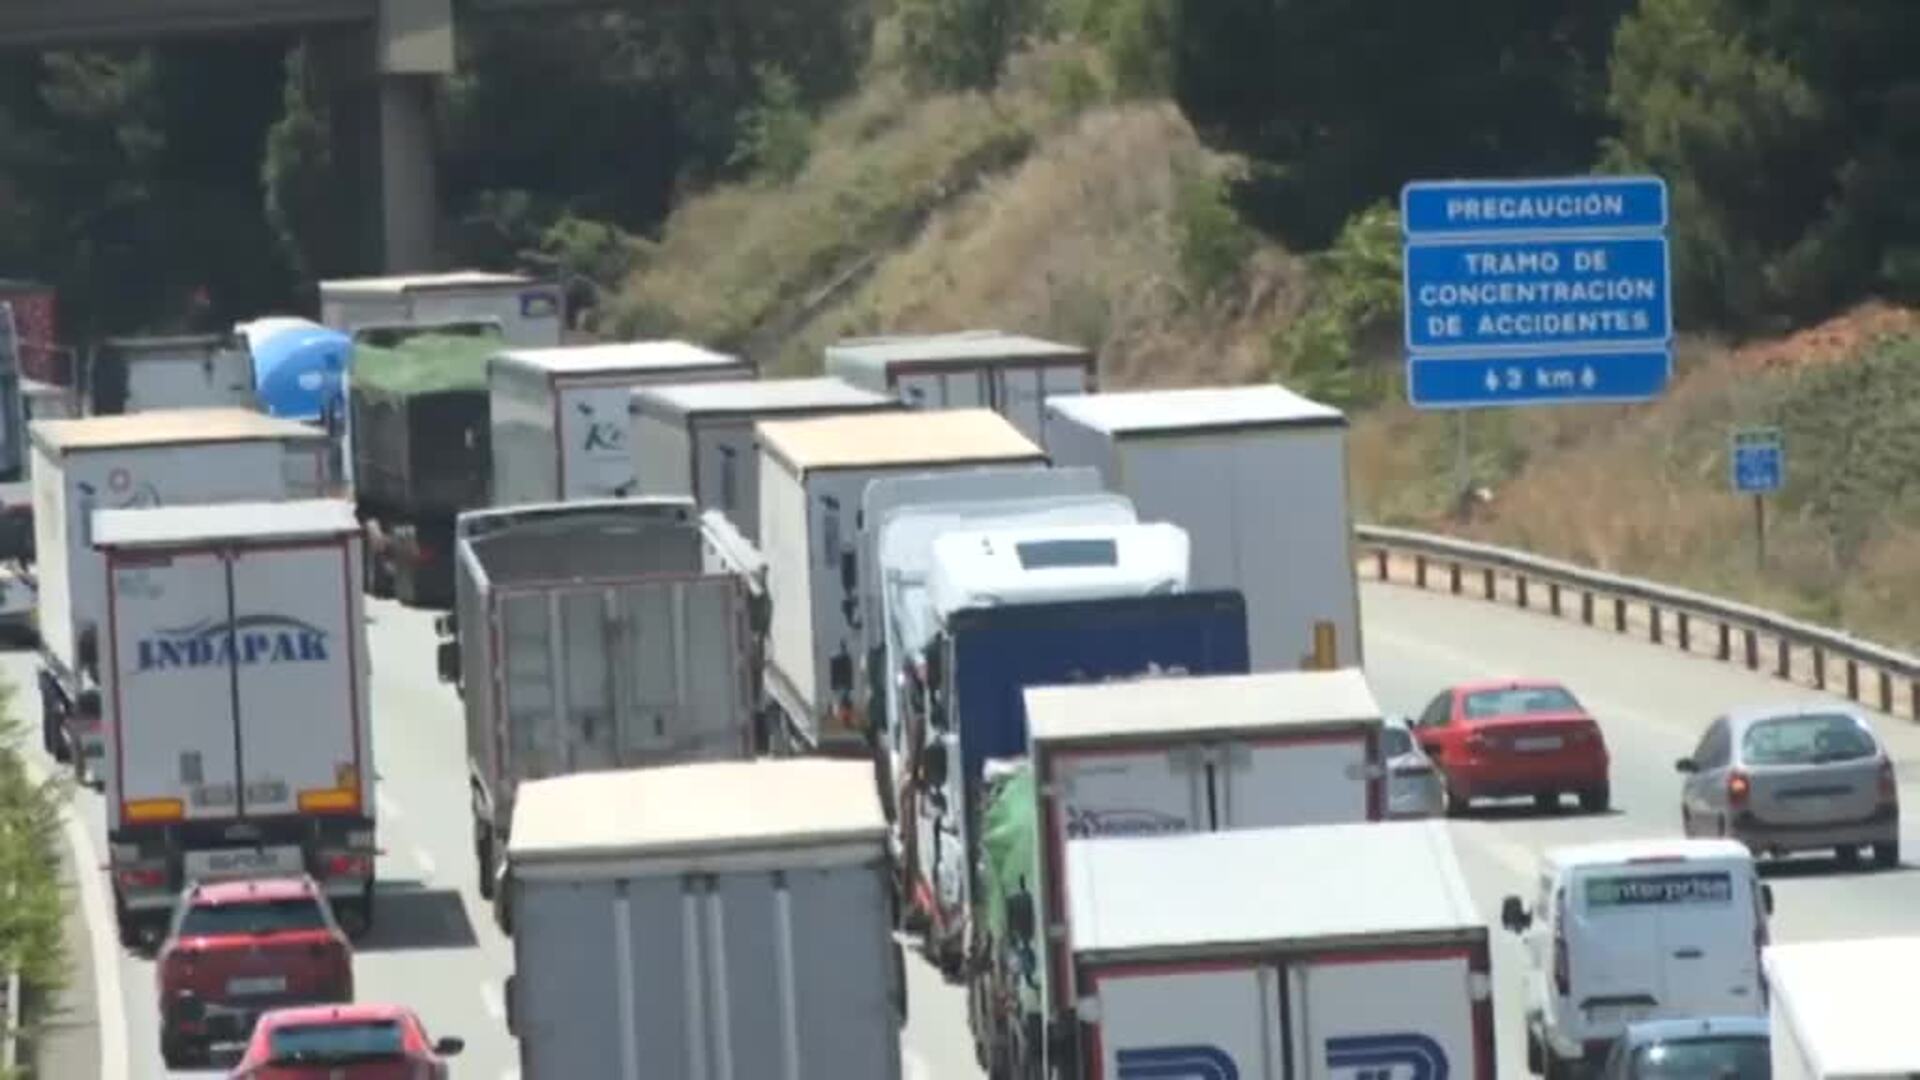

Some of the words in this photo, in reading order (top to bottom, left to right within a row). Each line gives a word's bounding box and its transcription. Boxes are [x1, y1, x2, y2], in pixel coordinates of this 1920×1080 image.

[1446, 194, 1624, 221] PRECAUCIÓN
[1465, 252, 1560, 275] TRAMO
[1574, 249, 1608, 271] DE
[1419, 278, 1655, 306] CONCENTRACIÓN
[1428, 316, 1462, 336] DE
[1477, 309, 1649, 335] ACCIDENTES
[1537, 367, 1575, 388] km
[136, 631, 328, 670] INDAPAK
